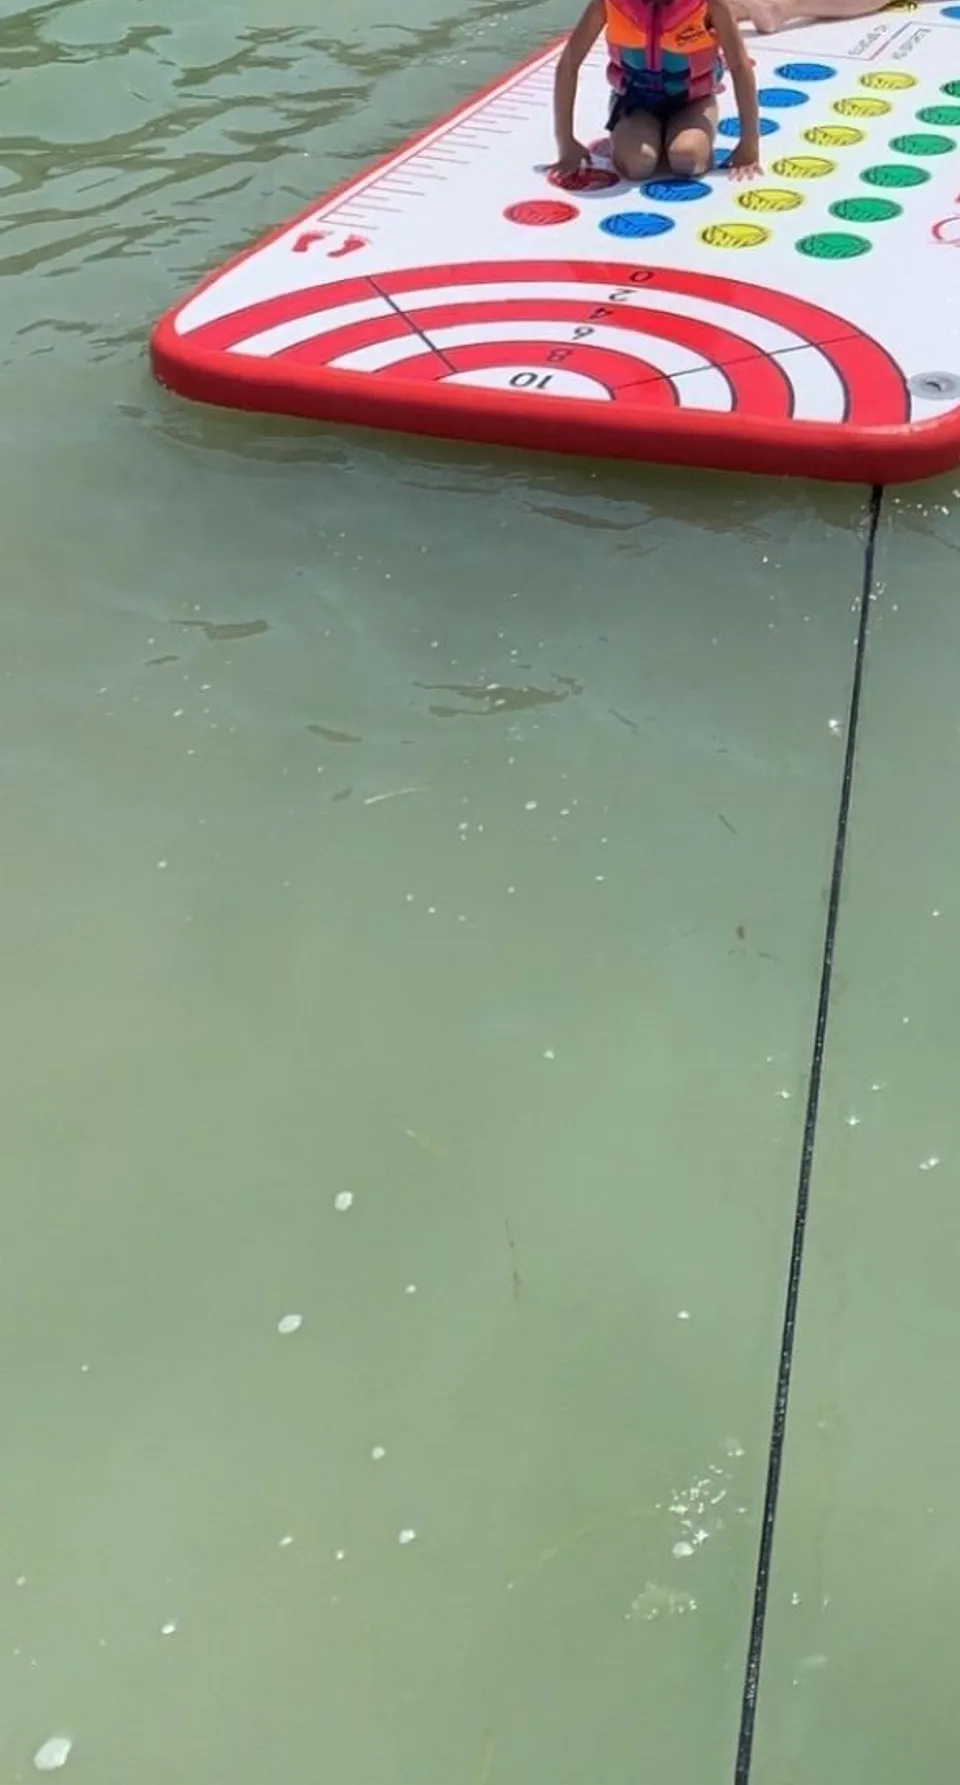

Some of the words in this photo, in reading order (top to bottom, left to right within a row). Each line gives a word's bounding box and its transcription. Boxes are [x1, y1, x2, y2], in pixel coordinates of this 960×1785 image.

[608, 288, 637, 302] 2
[546, 347, 573, 363] 8
[508, 371, 554, 390] 10
